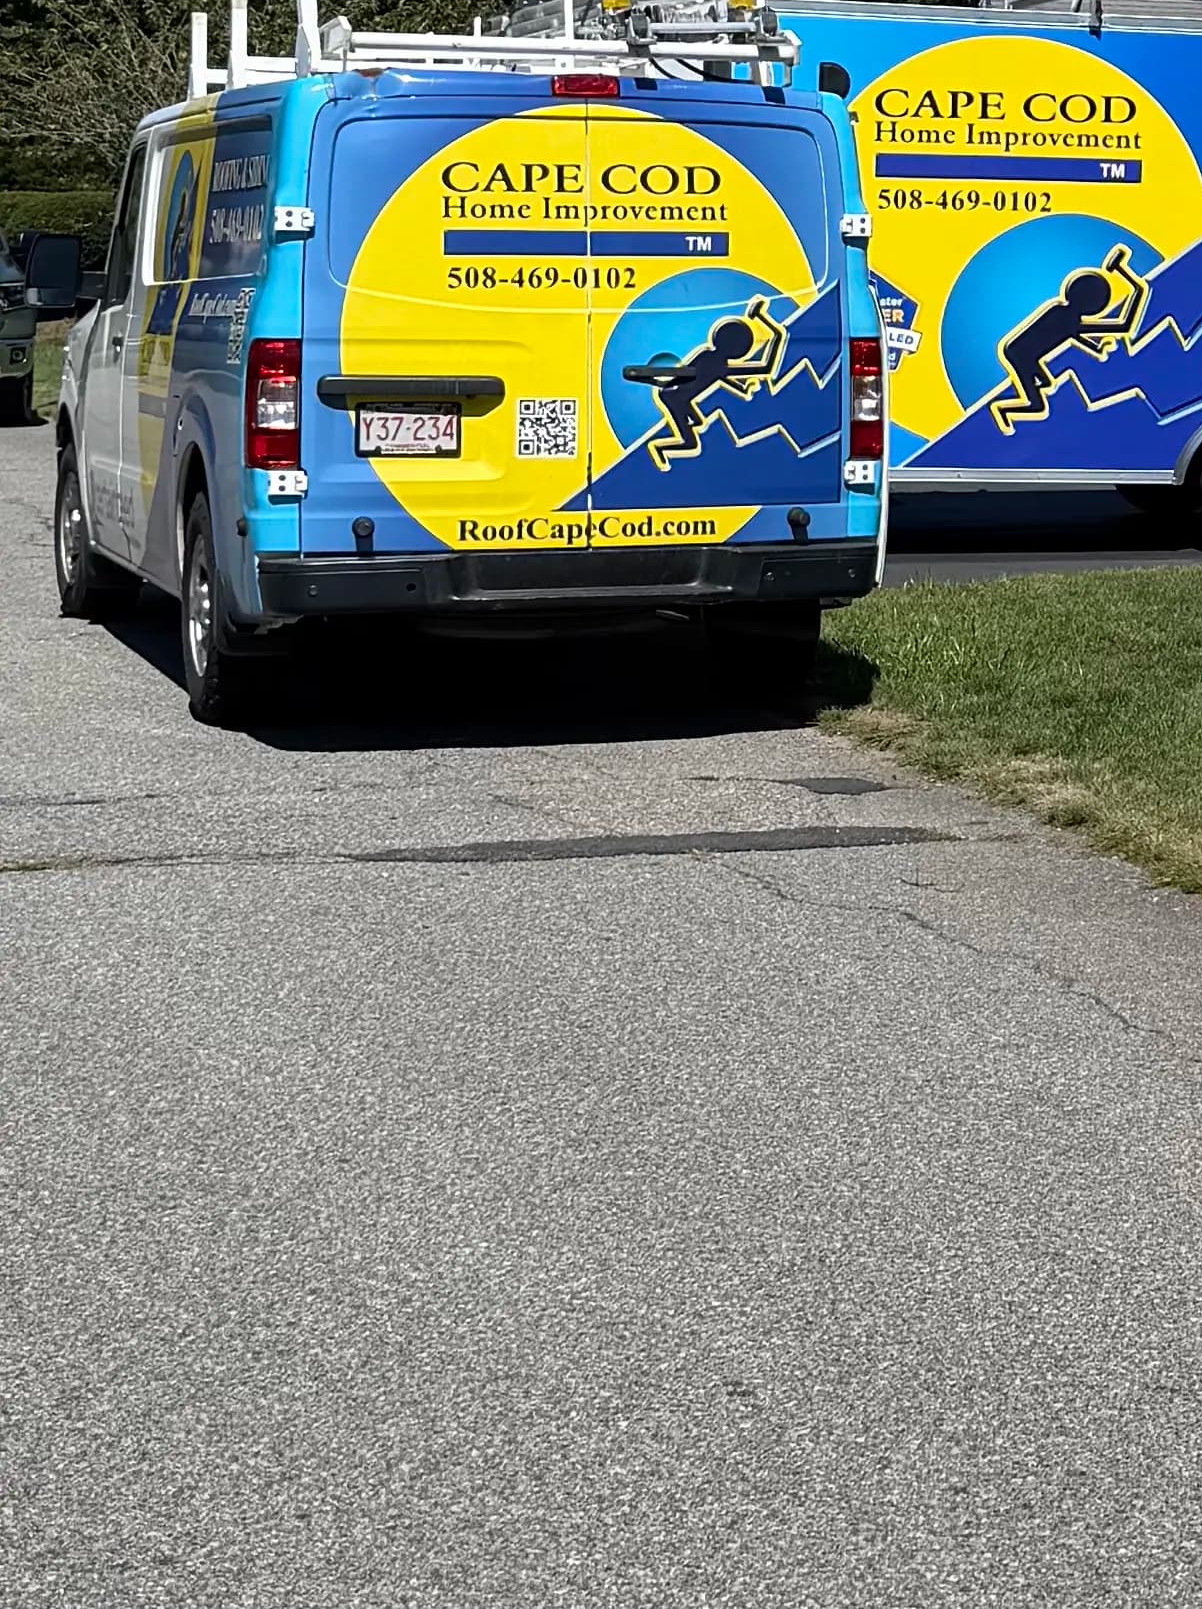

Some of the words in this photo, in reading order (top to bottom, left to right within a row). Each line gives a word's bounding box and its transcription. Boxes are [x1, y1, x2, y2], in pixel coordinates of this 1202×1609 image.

[875, 88, 1006, 120] CAPE
[1023, 92, 1137, 123] COD
[874, 121, 955, 144] Home
[965, 123, 1141, 152] Improvement
[441, 161, 584, 193] CAPE
[601, 164, 721, 195] COD
[1100, 162, 1126, 179] TM
[442, 195, 531, 219] Home
[543, 197, 728, 227] Improvement
[878, 189, 1052, 212] 508-469-0102
[685, 236, 712, 252] TM
[448, 266, 636, 289] 508-469-0102
[457, 515, 716, 545] RoofCapeCod.com
